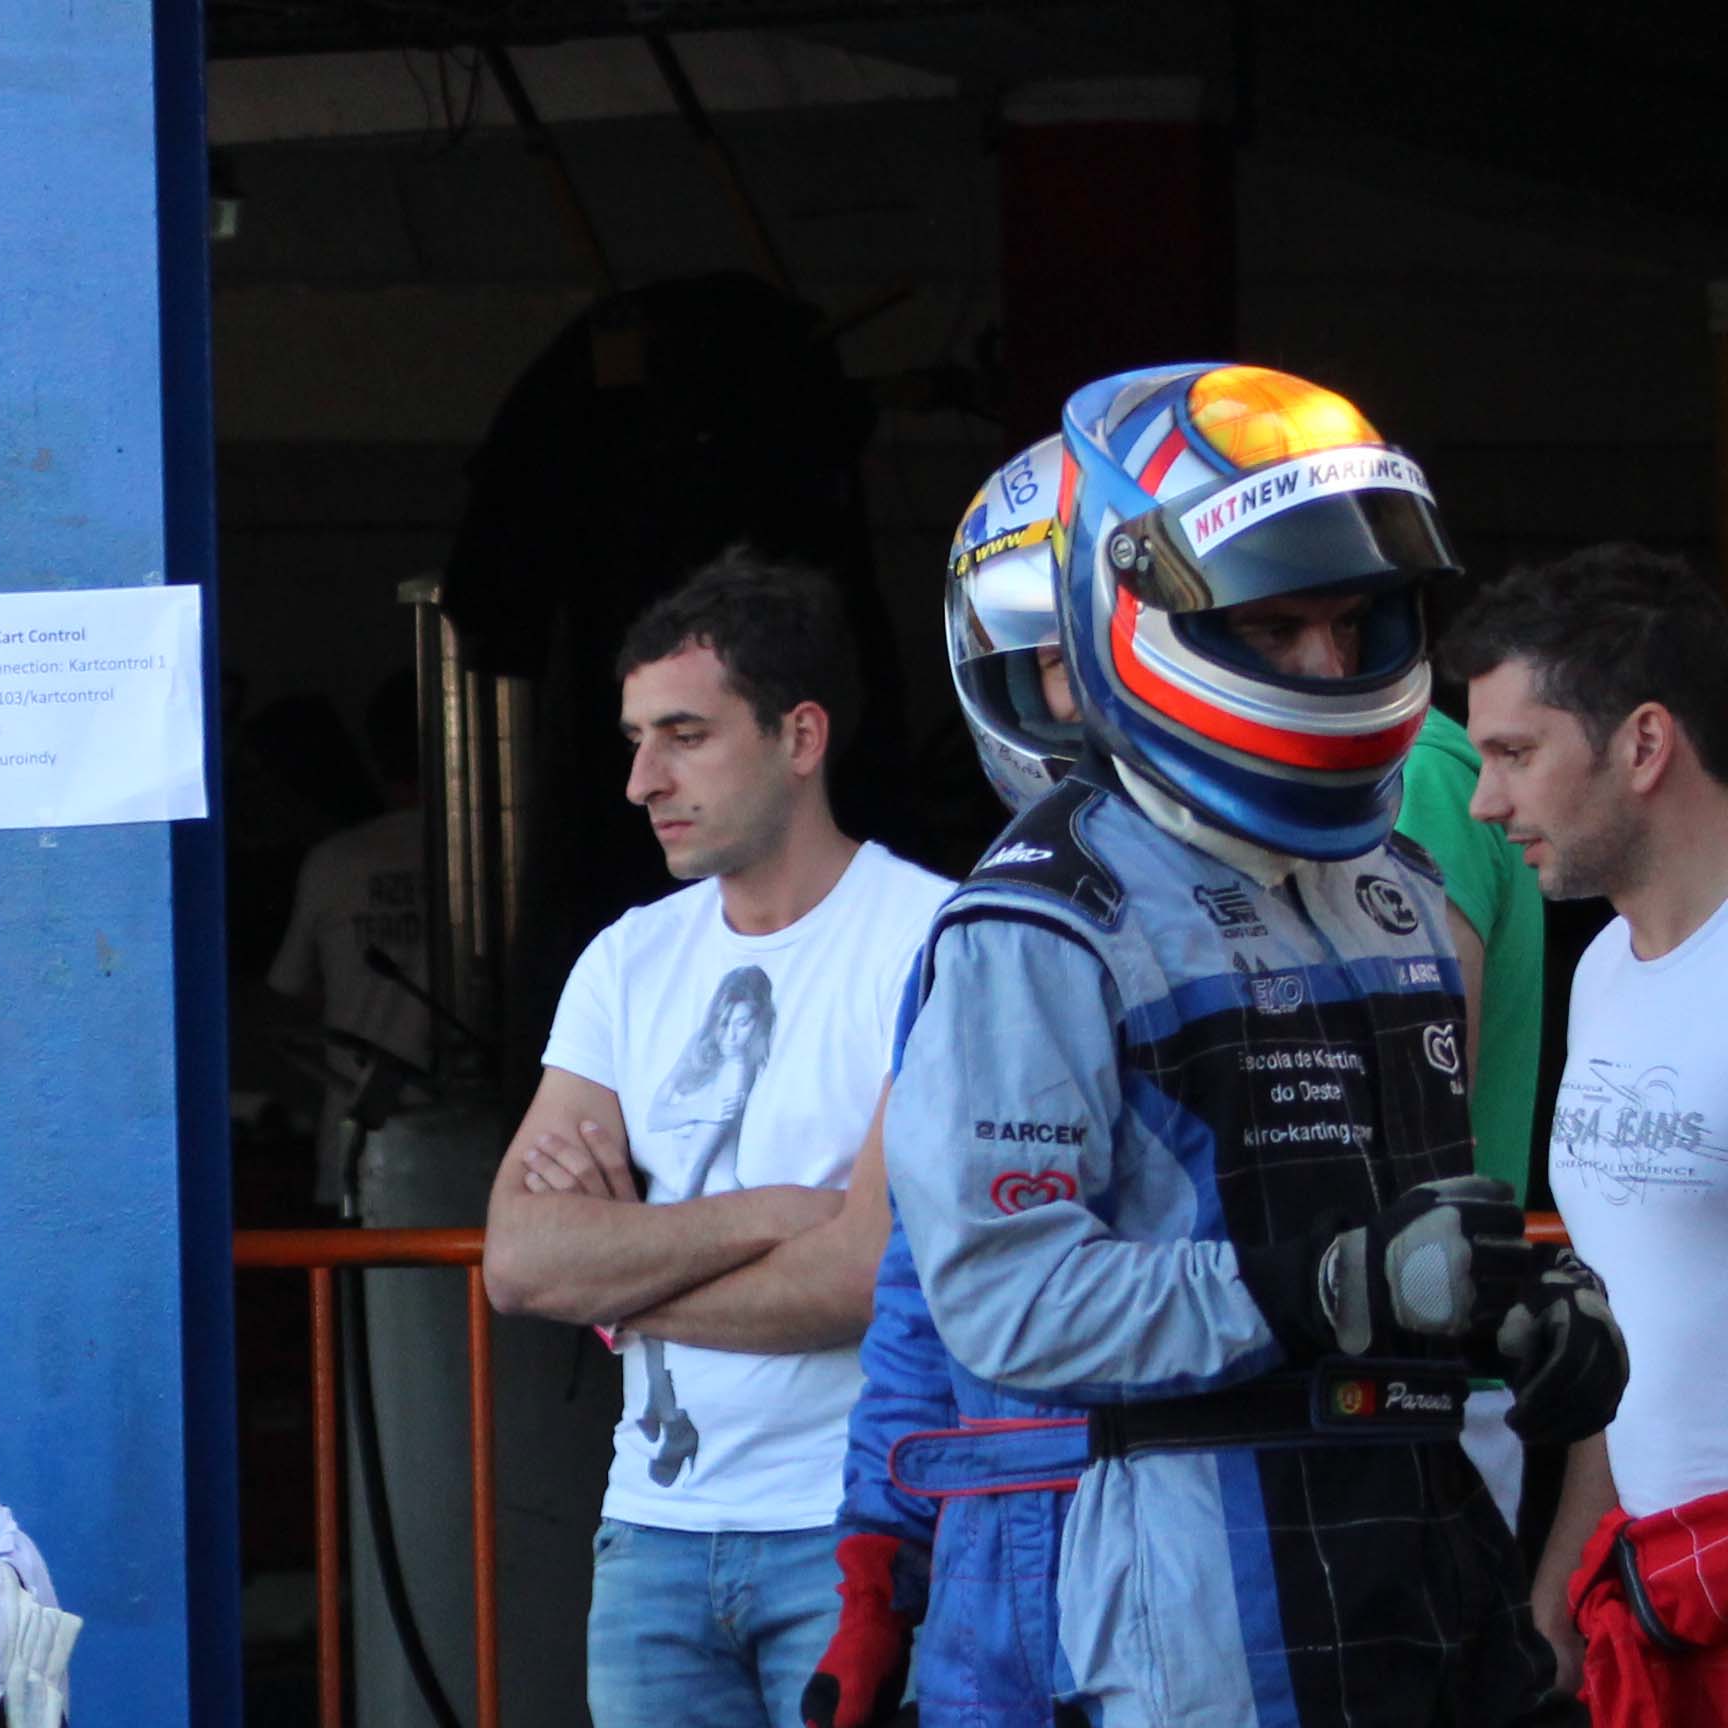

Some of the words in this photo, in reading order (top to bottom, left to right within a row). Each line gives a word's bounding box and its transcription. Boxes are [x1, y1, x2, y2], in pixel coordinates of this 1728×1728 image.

[1307, 459, 1403, 488] KARTING
[28, 627, 87, 643] Control
[68, 655, 154, 673] Kartcontrol
[1270, 1083, 1295, 1103] do
